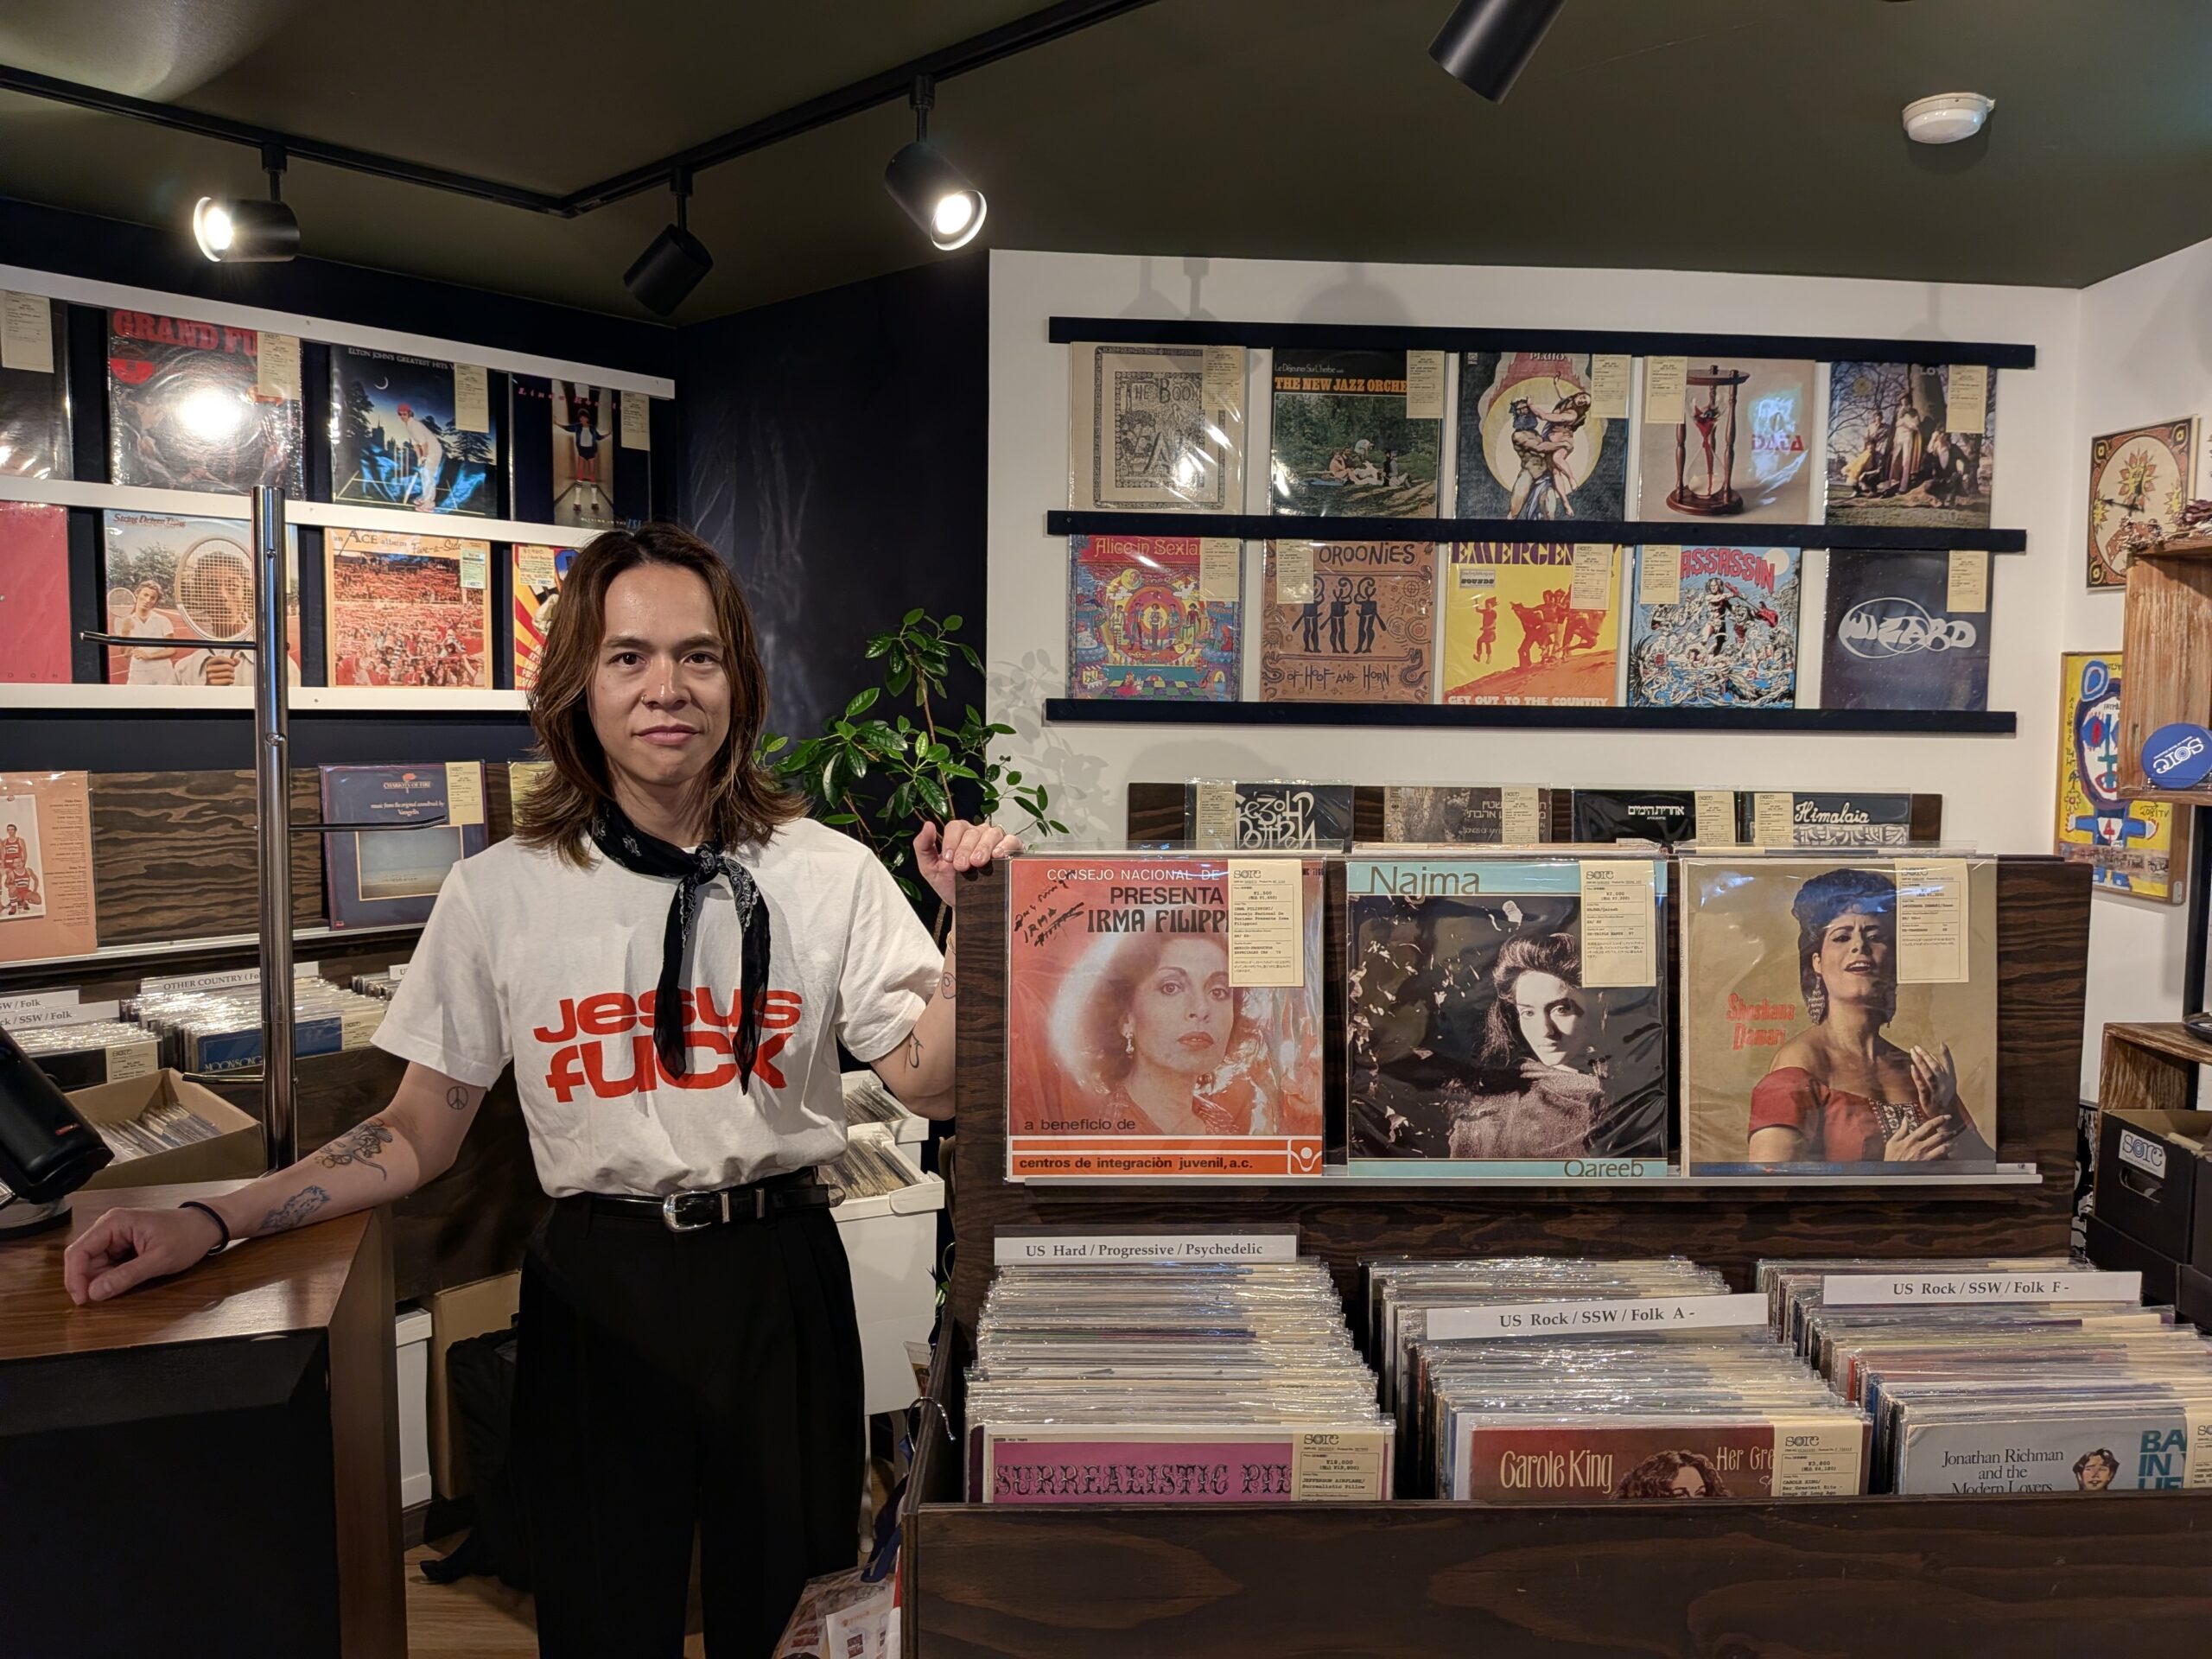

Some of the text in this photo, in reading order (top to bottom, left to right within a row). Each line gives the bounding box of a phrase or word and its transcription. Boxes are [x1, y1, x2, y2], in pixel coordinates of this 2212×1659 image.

[113, 309, 219, 350] GRAND
[347, 346, 371, 357] ELTON
[396, 355, 430, 366] GREATEST
[1274, 377, 1300, 390] THE
[1302, 378, 1332, 391] NEW
[1333, 378, 1366, 391] JAZZ
[1094, 537, 1133, 557] Alice
[1135, 537, 1150, 556] in
[1681, 547, 1775, 594] ASSASSIN
[1840, 602, 1977, 653] WIZARD
[1448, 696, 1609, 707] GET OUT TO THE COUNTRY
[1794, 800, 1870, 823] Himalaia
[1046, 869, 1220, 880] CONSEJO NACIONAL DE
[1370, 866, 1480, 902] Najma
[1110, 887, 1224, 905] PRESENTA
[1087, 910, 1146, 932] IRMA
[163, 979, 196, 991] OTHER
[197, 974, 243, 987] COUNTRY
[21, 999, 41, 1008] Folk
[19, 1014, 42, 1024] SSW
[51, 1010, 73, 1020] Folk
[1024, 1118, 1135, 1130] a beneficio de
[1019, 1157, 1071, 1169] centros
[1075, 1157, 1092, 1169] de
[1230, 1159, 1254, 1169] a.c.
[1563, 1158, 1644, 1177] Qareeb
[1026, 1243, 1263, 1258] US Hard Progressive Psychedelic
[1893, 1281, 2061, 1295] US Rock SSW Folk F
[1499, 1306, 1685, 1328] US Rock SSW Folk A
[2139, 1429, 2187, 1453] BA
[1716, 1446, 1744, 1471] Her
[1942, 1447, 2064, 1468] Jonathan Richman
[2138, 1453, 2172, 1477] IN
[995, 1463, 1230, 1497] SURREALISTIC
[1500, 1449, 1613, 1494] Carole King
[1978, 1465, 2028, 1480] and the
[1951, 1480, 2053, 1494] Modern Lovers
